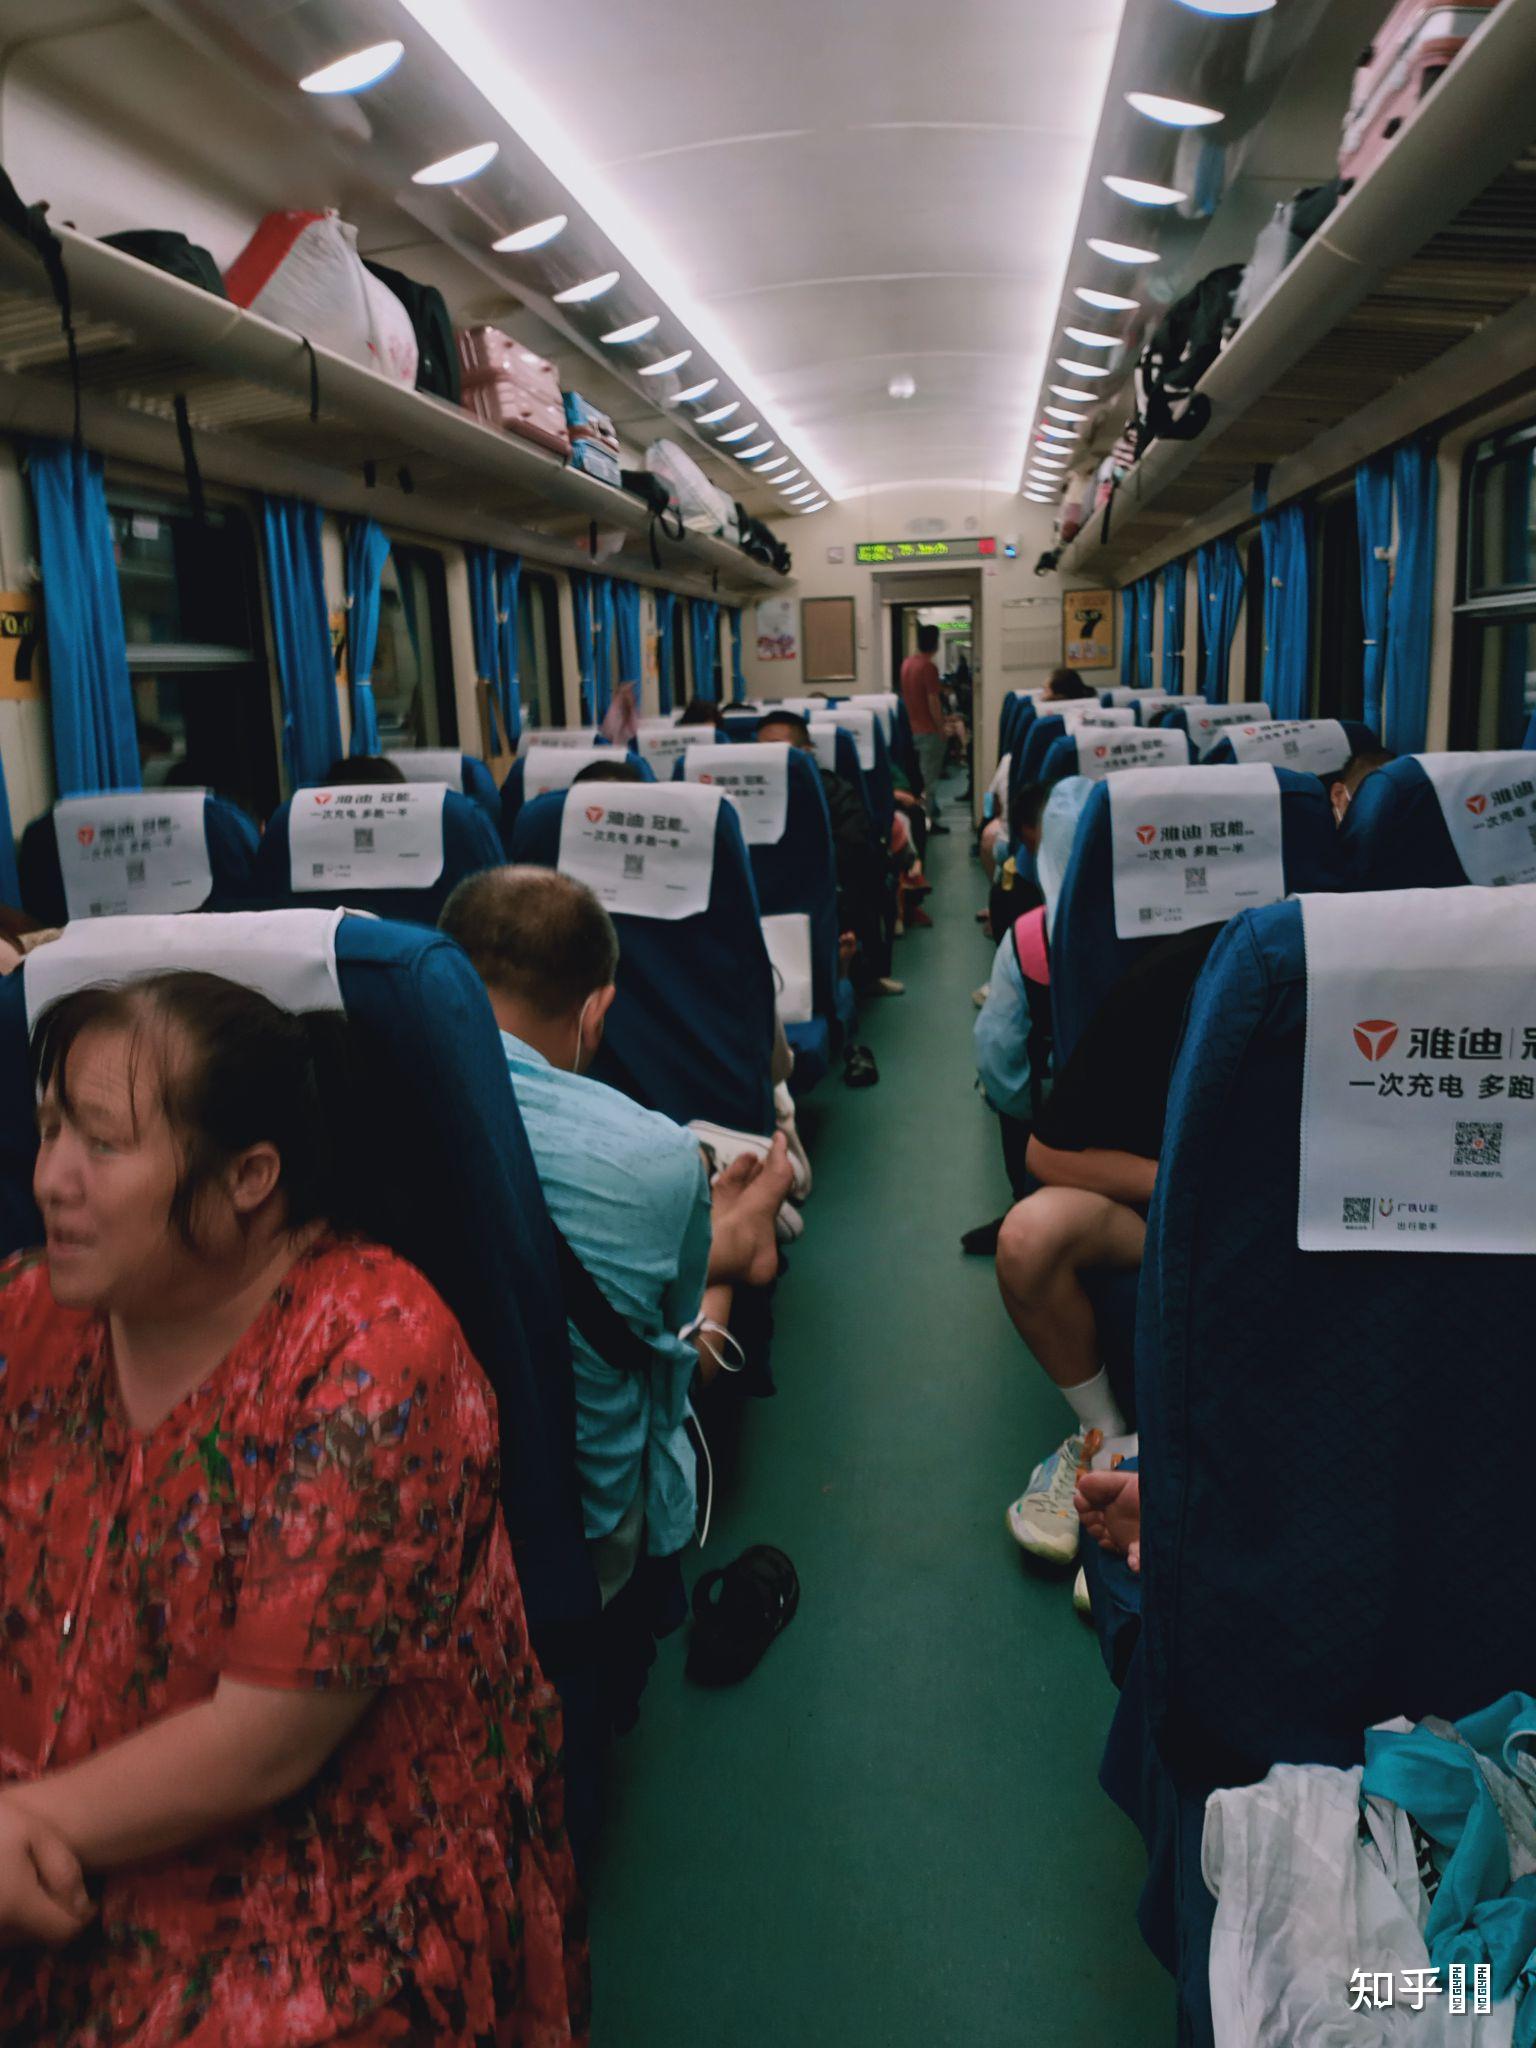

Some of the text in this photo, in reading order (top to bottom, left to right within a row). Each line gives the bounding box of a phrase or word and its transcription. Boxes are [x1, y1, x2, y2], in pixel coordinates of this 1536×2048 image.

[1406, 1026, 1503, 1060] 雅迪
[1349, 1072, 1464, 1099] 一次充电
